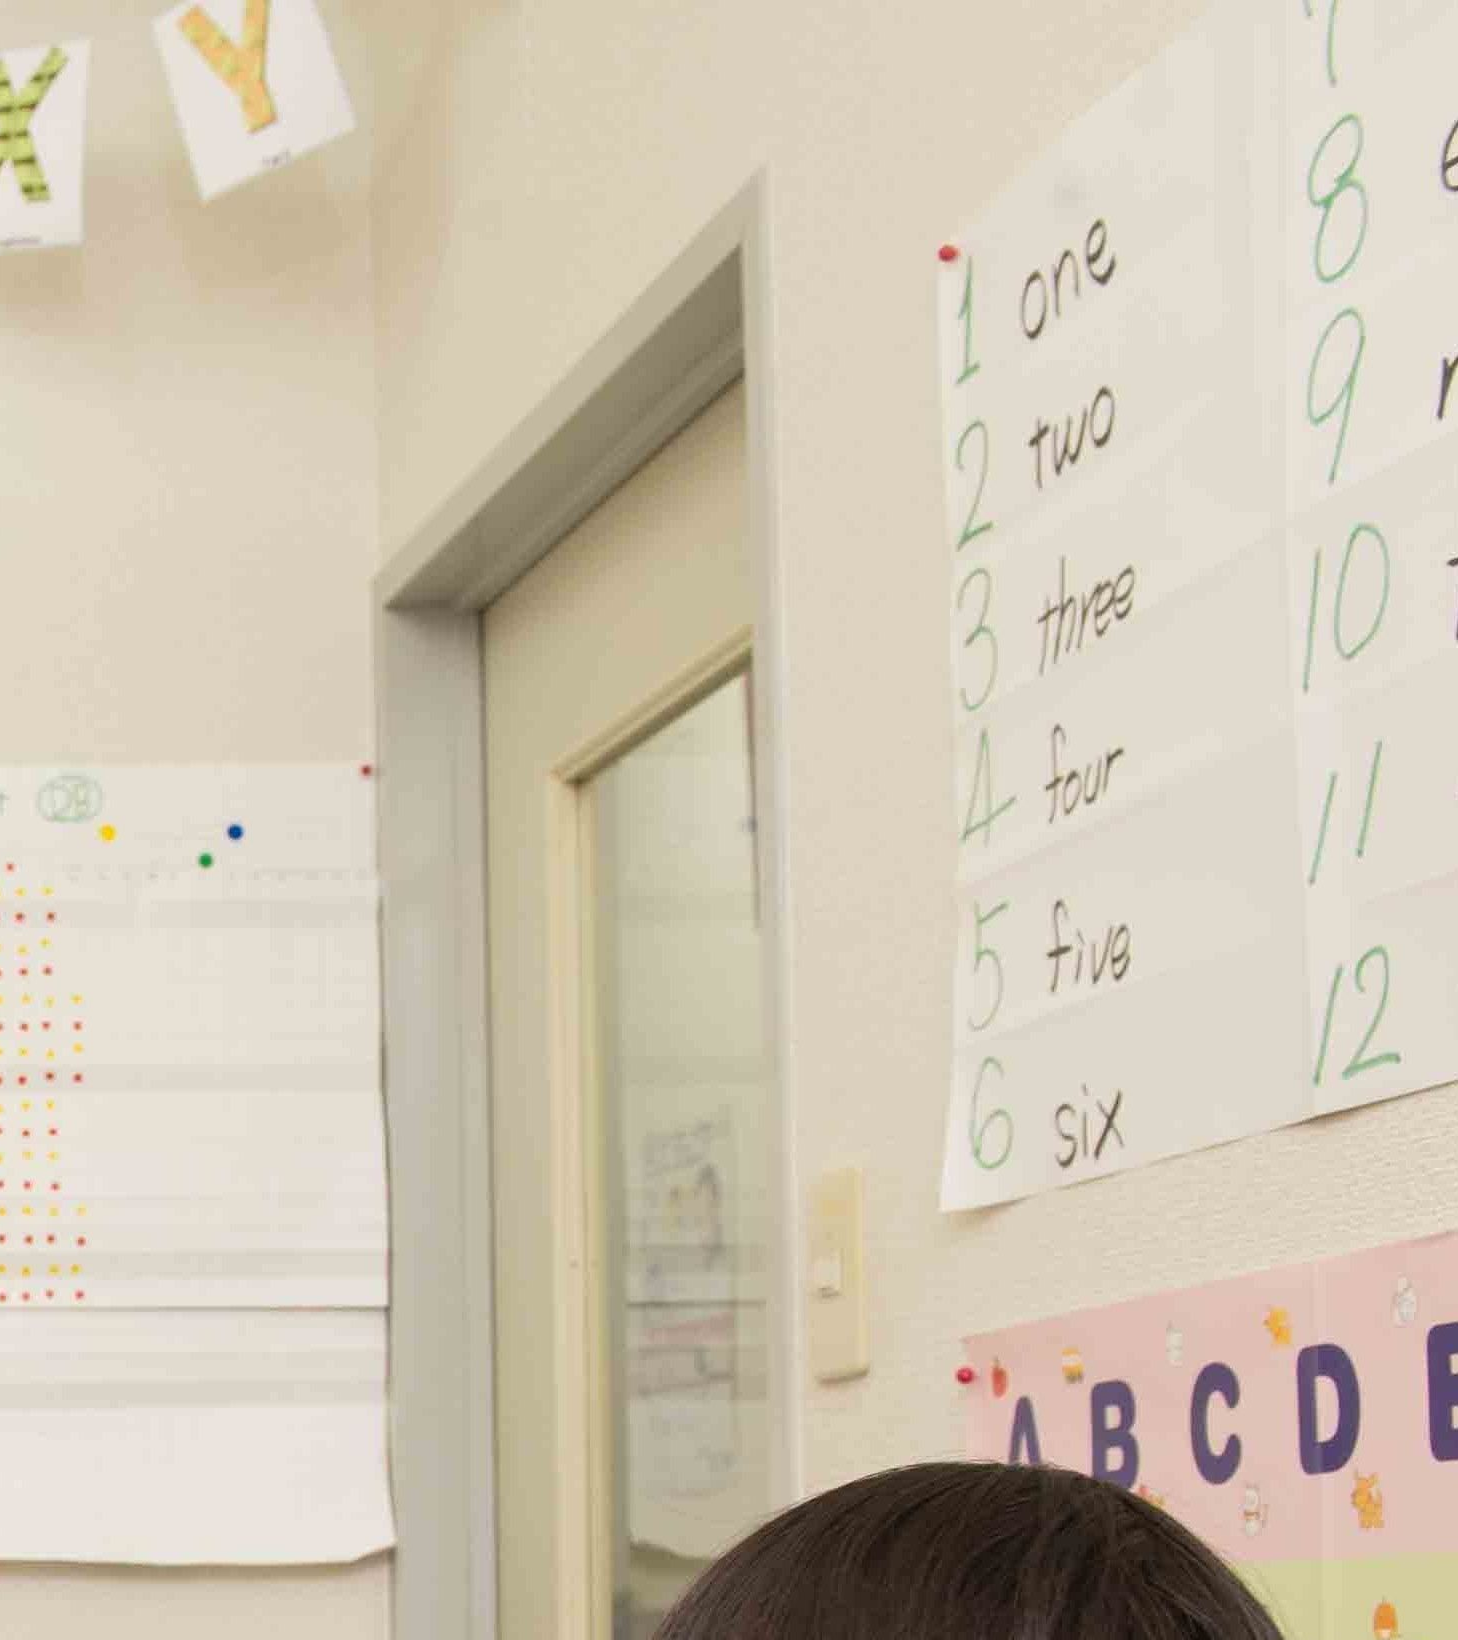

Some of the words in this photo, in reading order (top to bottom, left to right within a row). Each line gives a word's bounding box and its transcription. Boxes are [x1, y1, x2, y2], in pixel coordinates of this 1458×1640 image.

[174, 0, 278, 135] Y
[1307, 112, 1369, 283] 8
[956, 254, 981, 385] 1
[1020, 218, 1118, 340] one
[956, 420, 994, 552] 2
[1028, 385, 1116, 490] two
[1306, 307, 1368, 485] 9
[957, 567, 999, 712] 3
[1037, 556, 1136, 676] three
[1302, 522, 1391, 693] 10
[960, 727, 1017, 847] 4
[1044, 723, 1125, 824] four
[1307, 739, 1383, 885] 11
[967, 900, 1009, 1031] 5
[1045, 899, 1132, 993] five
[1312, 944, 1402, 1086] 12
[968, 1056, 1015, 1170] 6
[1053, 1083, 1125, 1169] six
[1089, 1379, 1140, 1491] B
[1189, 1361, 1243, 1485] C
[1296, 1342, 1361, 1476] D
